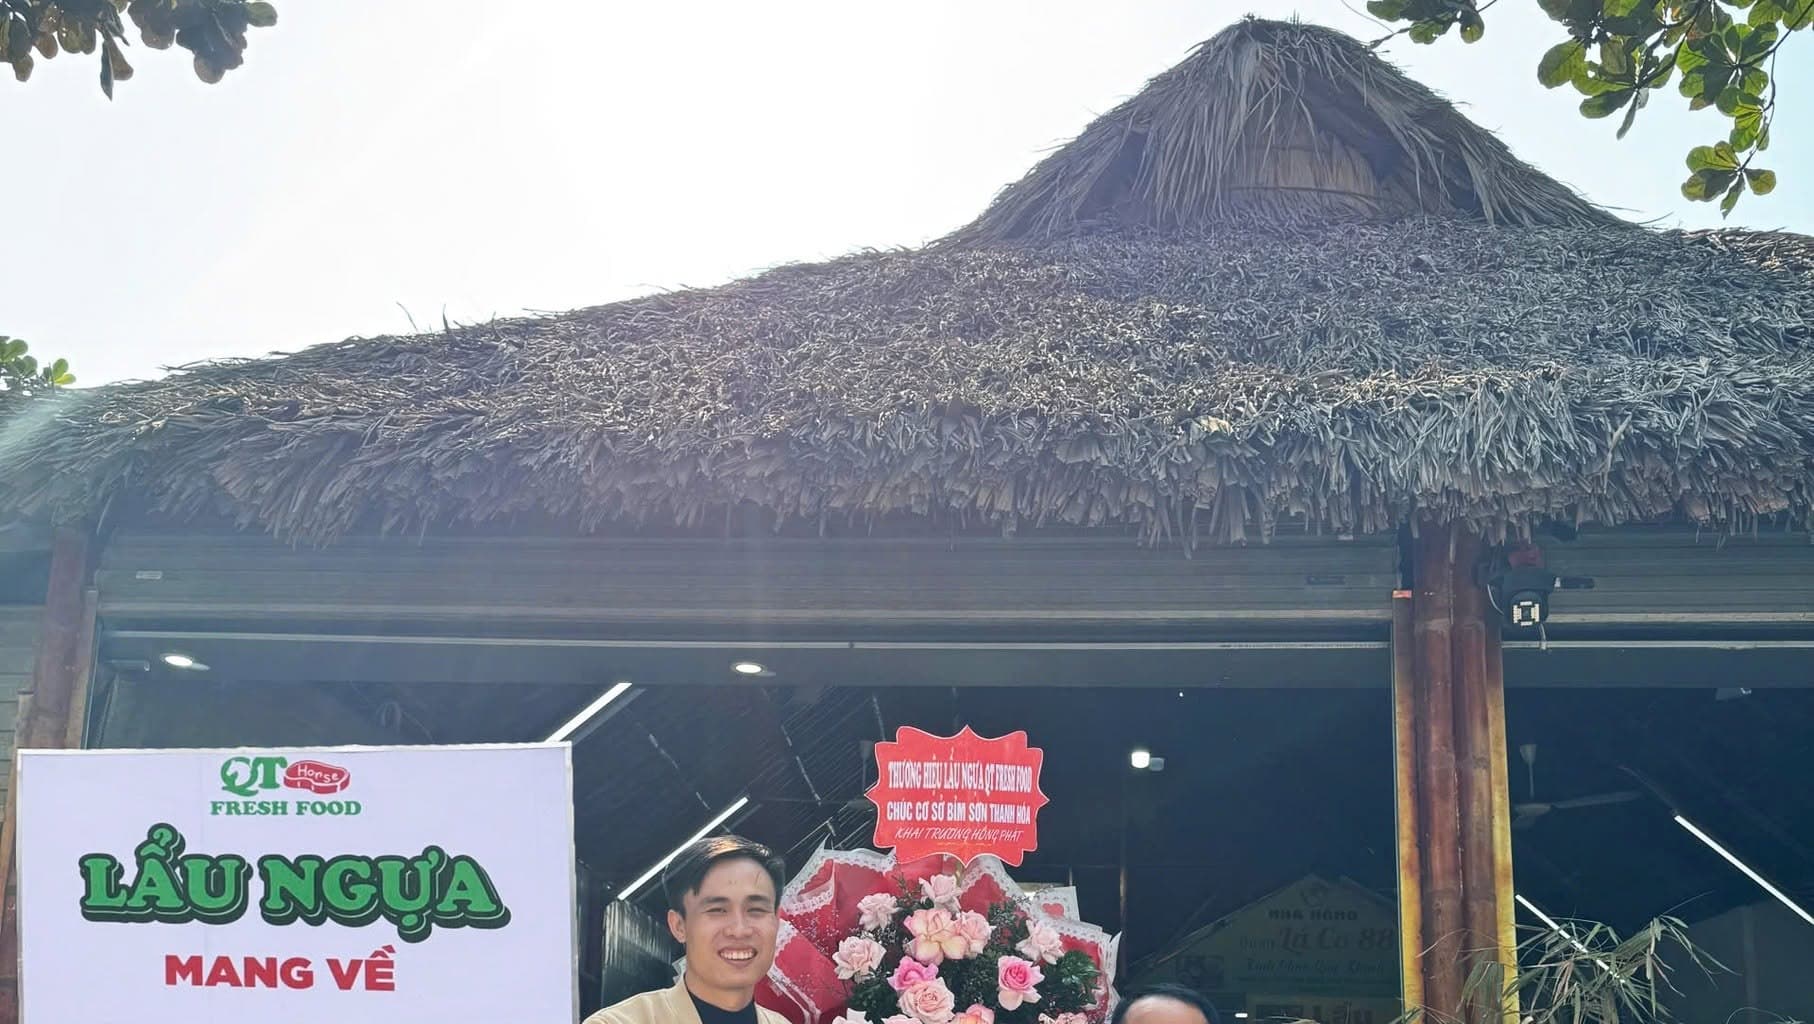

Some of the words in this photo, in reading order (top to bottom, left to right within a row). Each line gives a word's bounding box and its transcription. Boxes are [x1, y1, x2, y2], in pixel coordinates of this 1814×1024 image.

[220, 756, 288, 797] QT
[297, 764, 340, 784] Horse
[888, 759, 922, 789] THƯƠNG
[923, 753, 942, 797] HIỆU
[984, 763, 995, 797] QT
[995, 763, 1016, 792] FRESH
[1016, 765, 1033, 793] FOOD
[210, 800, 289, 816] FRESH
[295, 800, 362, 816] FOOD
[887, 797, 913, 821] CHÚC
[915, 799, 930, 821] CƠ
[968, 801, 988, 822] SƠN
[989, 803, 1015, 824] THANH
[894, 826, 925, 839] KHAI
[79, 822, 253, 926] LẨU
[258, 845, 512, 944] NGỰA
[164, 954, 314, 990] MANG
[326, 944, 396, 992] VỀ
